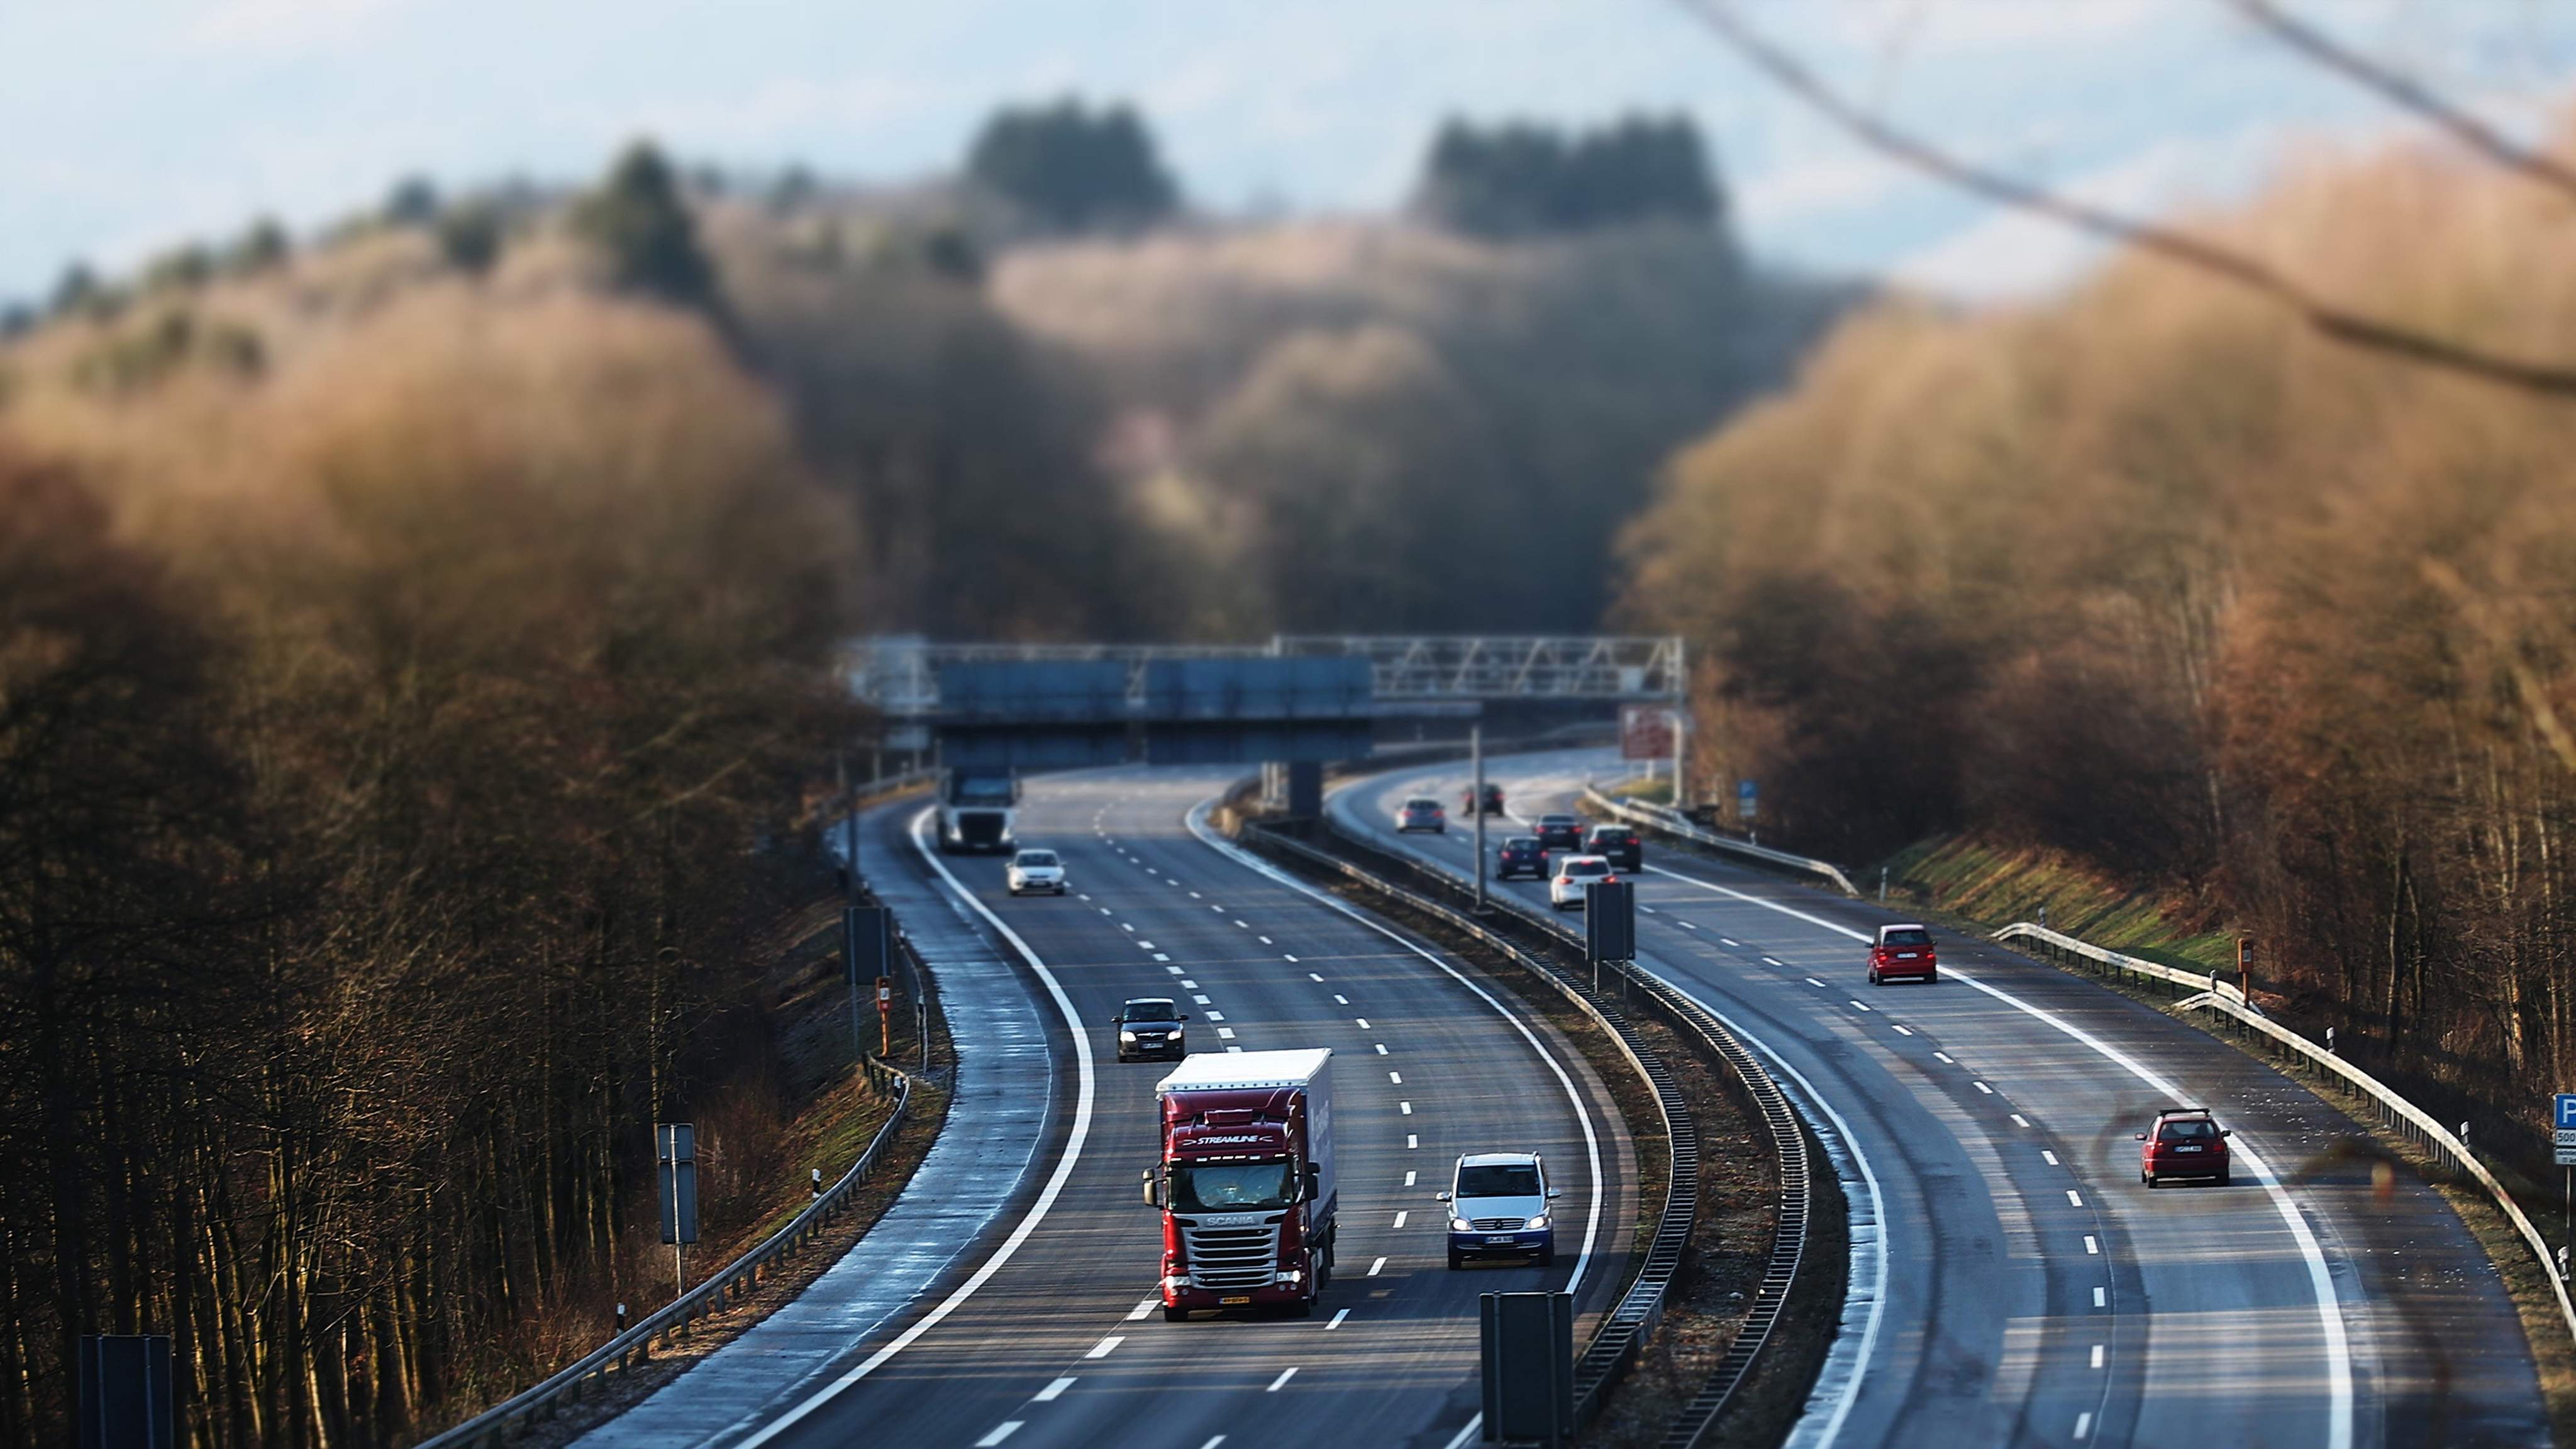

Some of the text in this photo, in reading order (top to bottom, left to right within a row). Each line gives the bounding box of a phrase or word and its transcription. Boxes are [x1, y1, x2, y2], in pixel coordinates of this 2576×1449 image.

[2563, 1099, 2576, 1123] P
[1197, 1135, 1258, 1145] STREAMLINE
[2558, 1133, 2576, 1142] 500
[1207, 1216, 1255, 1226] SCANIA
